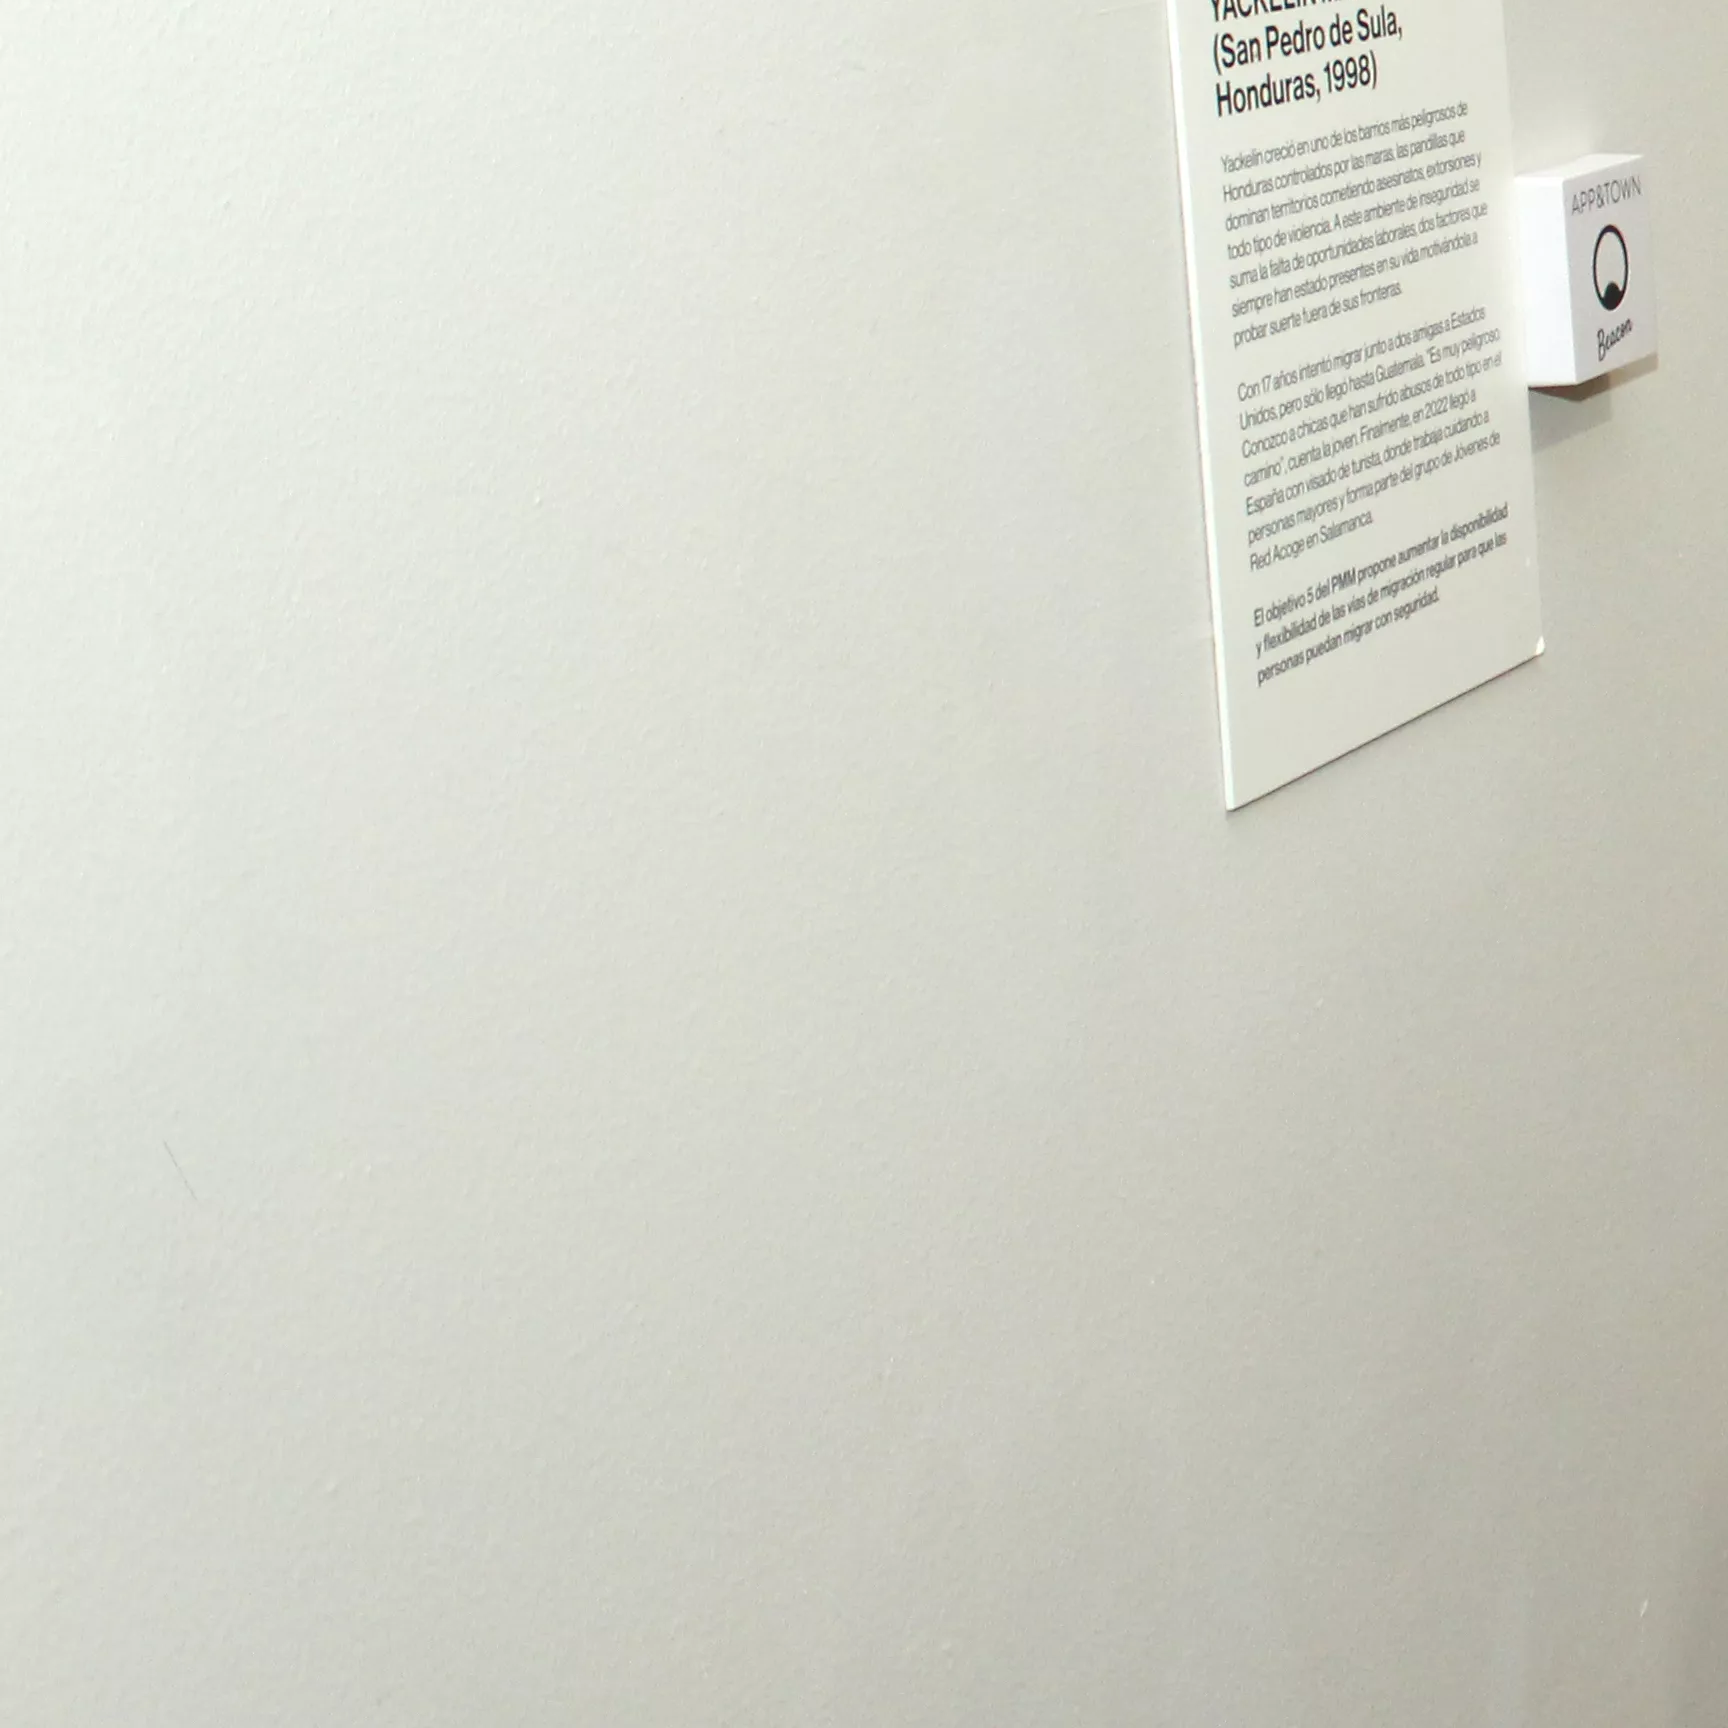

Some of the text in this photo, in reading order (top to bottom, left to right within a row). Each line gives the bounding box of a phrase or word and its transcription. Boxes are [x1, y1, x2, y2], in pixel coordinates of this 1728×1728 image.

[1212, 4, 1402, 75] (San Pedro de Sula,
[1215, 49, 1377, 117] Honduras, 1998)
[1221, 99, 1468, 174] Yackelin creció en uno de los barrios más peligrosos de
[1222, 177, 1273, 202] Honduras
[1274, 160, 1332, 189] controlados
[1334, 158, 1349, 178] por
[1350, 152, 1364, 170] las
[1396, 141, 1408, 159] las
[1410, 131, 1448, 159] pandillas
[1448, 130, 1464, 149] que
[1225, 207, 1270, 231] dominan
[1271, 193, 1318, 219] territorios
[1426, 153, 1476, 178] extorsiones
[1227, 237, 1251, 260] todo
[1253, 234, 1272, 255] tipo
[1273, 228, 1287, 247] de
[1333, 212, 1341, 231] A
[1342, 208, 1362, 228] este
[1363, 196, 1405, 222] ambiente
[1405, 192, 1418, 211] de
[1571, 175, 1641, 216] APP&TOWN
[1229, 268, 1257, 289] suma
[1258, 262, 1268, 281] la
[1268, 256, 1290, 278] falta
[1292, 251, 1305, 271] de
[1306, 233, 1374, 269] oportunidades
[1417, 216, 1435, 234] dos
[1471, 202, 1487, 222] que
[1231, 245, 1419, 317] siempre han estado presentes en su vida
[1233, 321, 1267, 351] probar
[1269, 310, 1300, 335] suerte
[1302, 304, 1328, 325] fuera
[1328, 297, 1341, 316] de
[1342, 294, 1358, 312] sus
[1237, 305, 1485, 402] Con 17 años intentó migrar junto a dos amigas Estados
[1597, 318, 1633, 362] Beacon
[1241, 429, 1288, 459] Conozco
[1288, 427, 1295, 442] a
[1296, 415, 1328, 439] chicas
[1329, 408, 1347, 431] que
[1348, 401, 1366, 420] han
[1432, 371, 1444, 390] de
[1445, 364, 1464, 385] todo
[1279, 396, 1302, 421] pero
[1303, 386, 1323, 409] sólo
[1325, 375, 1347, 401] llegó
[1348, 369, 1374, 393] hasta
[1288, 444, 1321, 471] cuenta
[1322, 439, 1330, 458] la
[1412, 408, 1423, 424] en
[1424, 395, 1448, 420] 2022
[1449, 386, 1469, 411] llegó
[1245, 486, 1284, 515] España
[1285, 480, 1304, 500] con
[1305, 465, 1336, 493] visado
[1337, 460, 1350, 480] de
[1382, 437, 1411, 463] donde
[1444, 410, 1482, 439] cuidando
[1248, 429, 1500, 548] personas mayores y forma parte del grupo de Jóvenes de
[1249, 546, 1271, 572] Red
[1272, 537, 1304, 563] Acoge
[1306, 532, 1318, 549] en
[1253, 500, 1508, 627] El objetivo 5 del PMM propone aumentar la disponibilidad
[1255, 531, 1507, 659] y flexibilidad de las vías de migración regular para que las
[1257, 649, 1304, 687] personas
[1305, 632, 1342, 665] puedan
[1343, 618, 1373, 644] migrar
[1374, 609, 1392, 630] con
